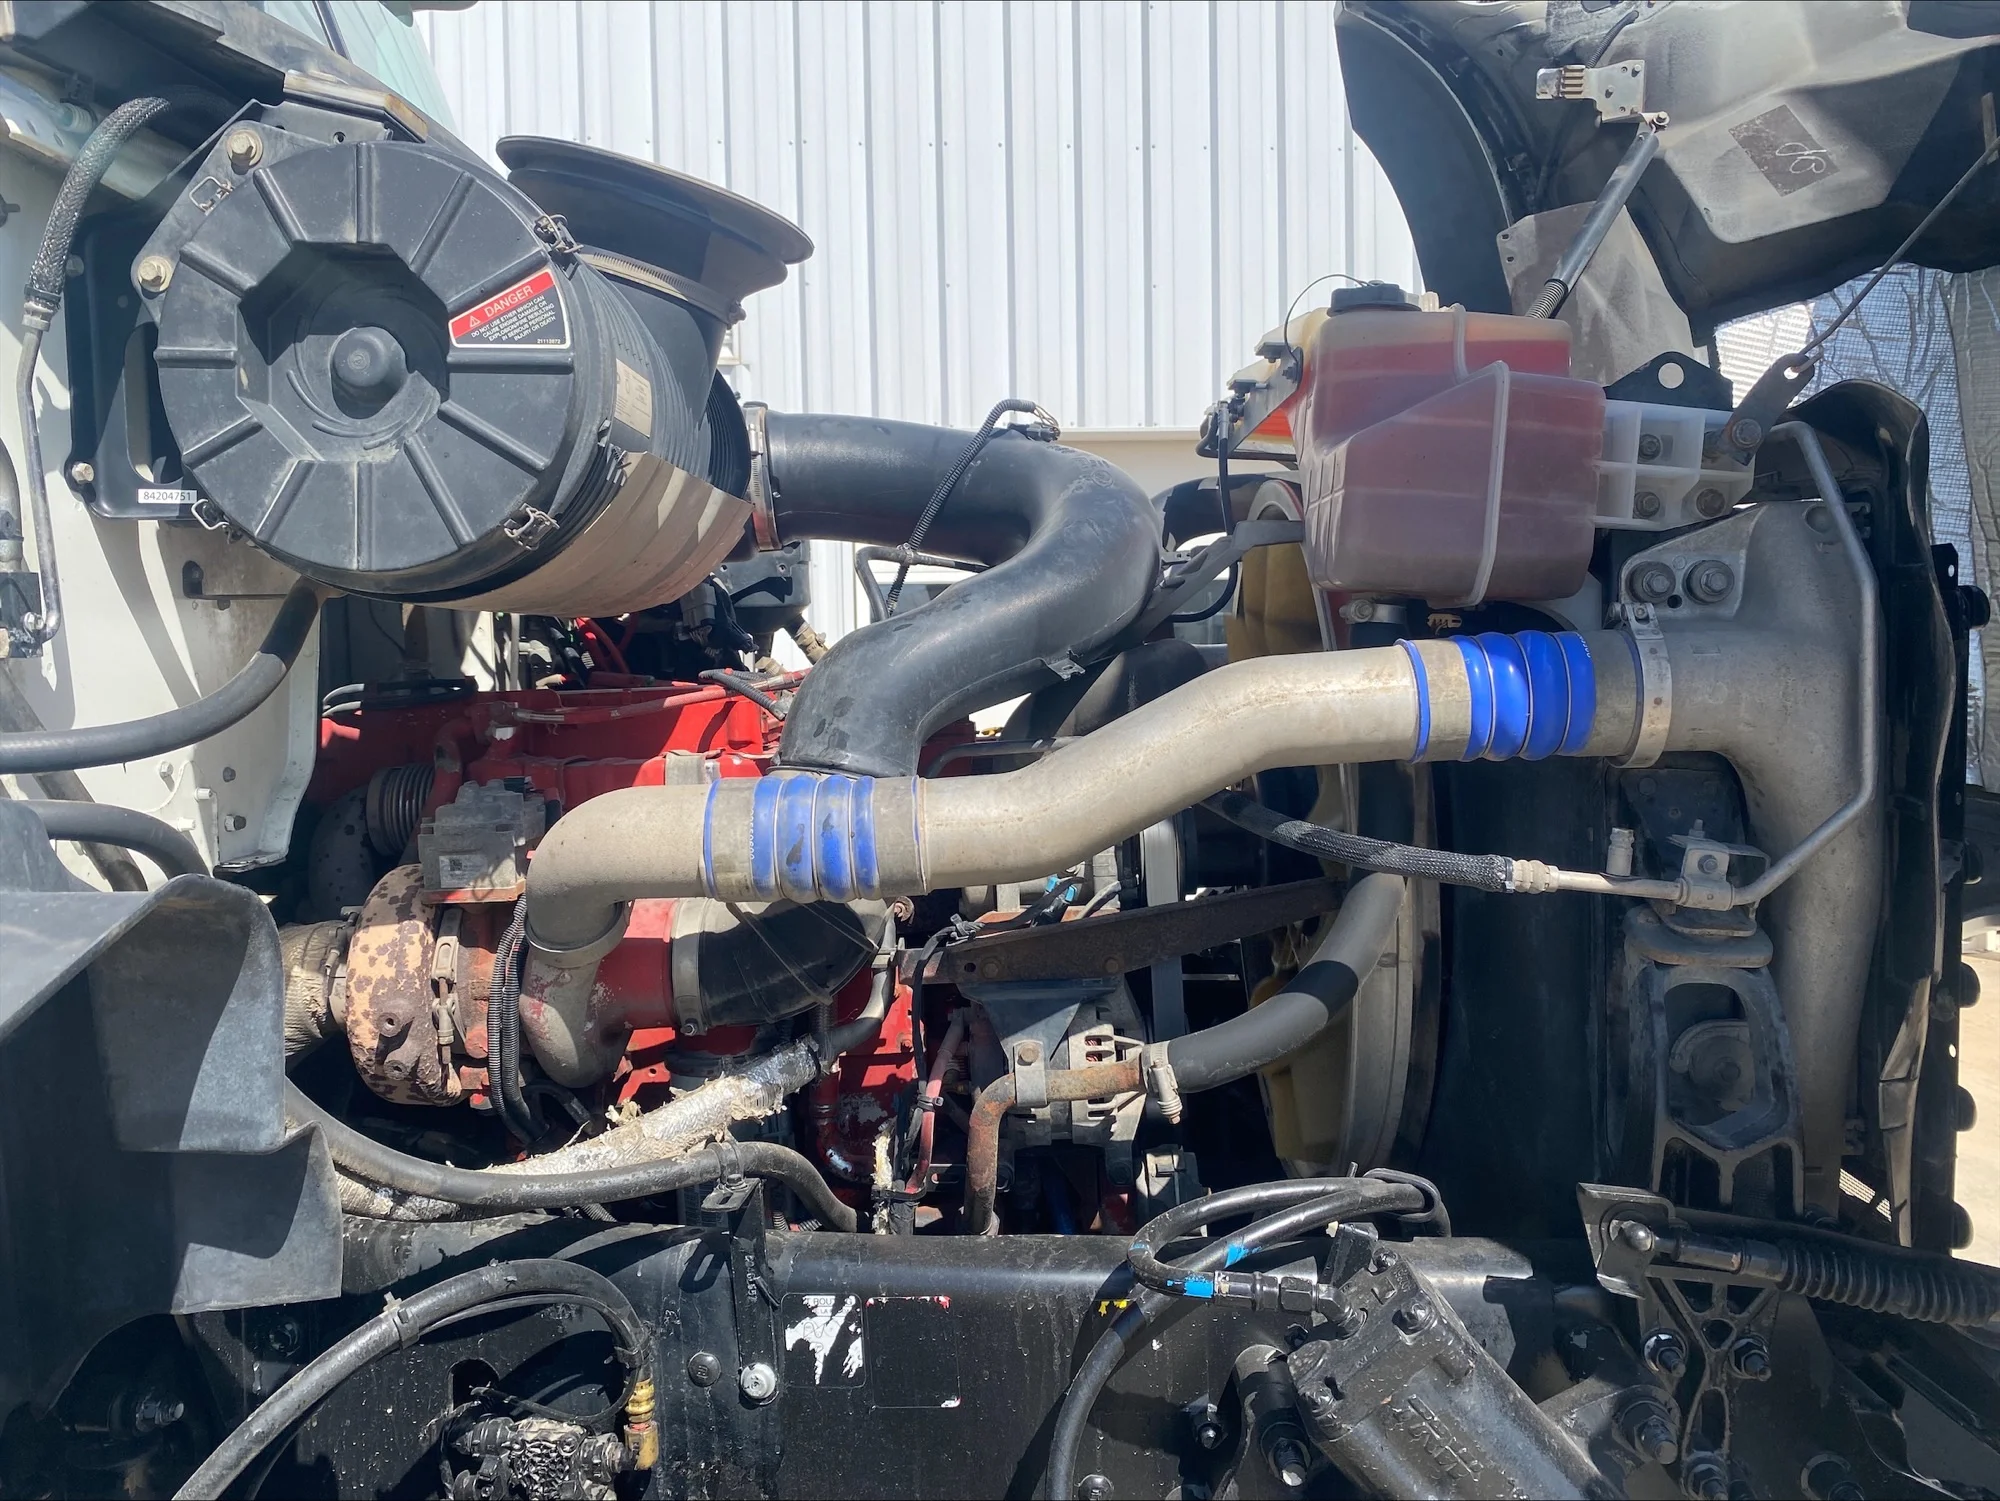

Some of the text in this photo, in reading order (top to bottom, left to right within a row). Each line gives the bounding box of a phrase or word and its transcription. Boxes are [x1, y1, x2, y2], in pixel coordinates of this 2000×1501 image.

[484, 285, 533, 317] DANGER
[527, 302, 554, 320] RESULTING
[470, 294, 544, 338] DO NOT USE ETHER WHICH CAN
[482, 326, 500, 338] CAUSE
[499, 316, 518, 329] ENGINE
[517, 304, 539, 319] DAMAGE
[507, 322, 529, 337] SERIOUS
[528, 309, 555, 326] PERSONAL
[513, 328, 532, 341] INJURY
[539, 315, 556, 327] DEATH
[143, 492, 190, 500] 84204751
